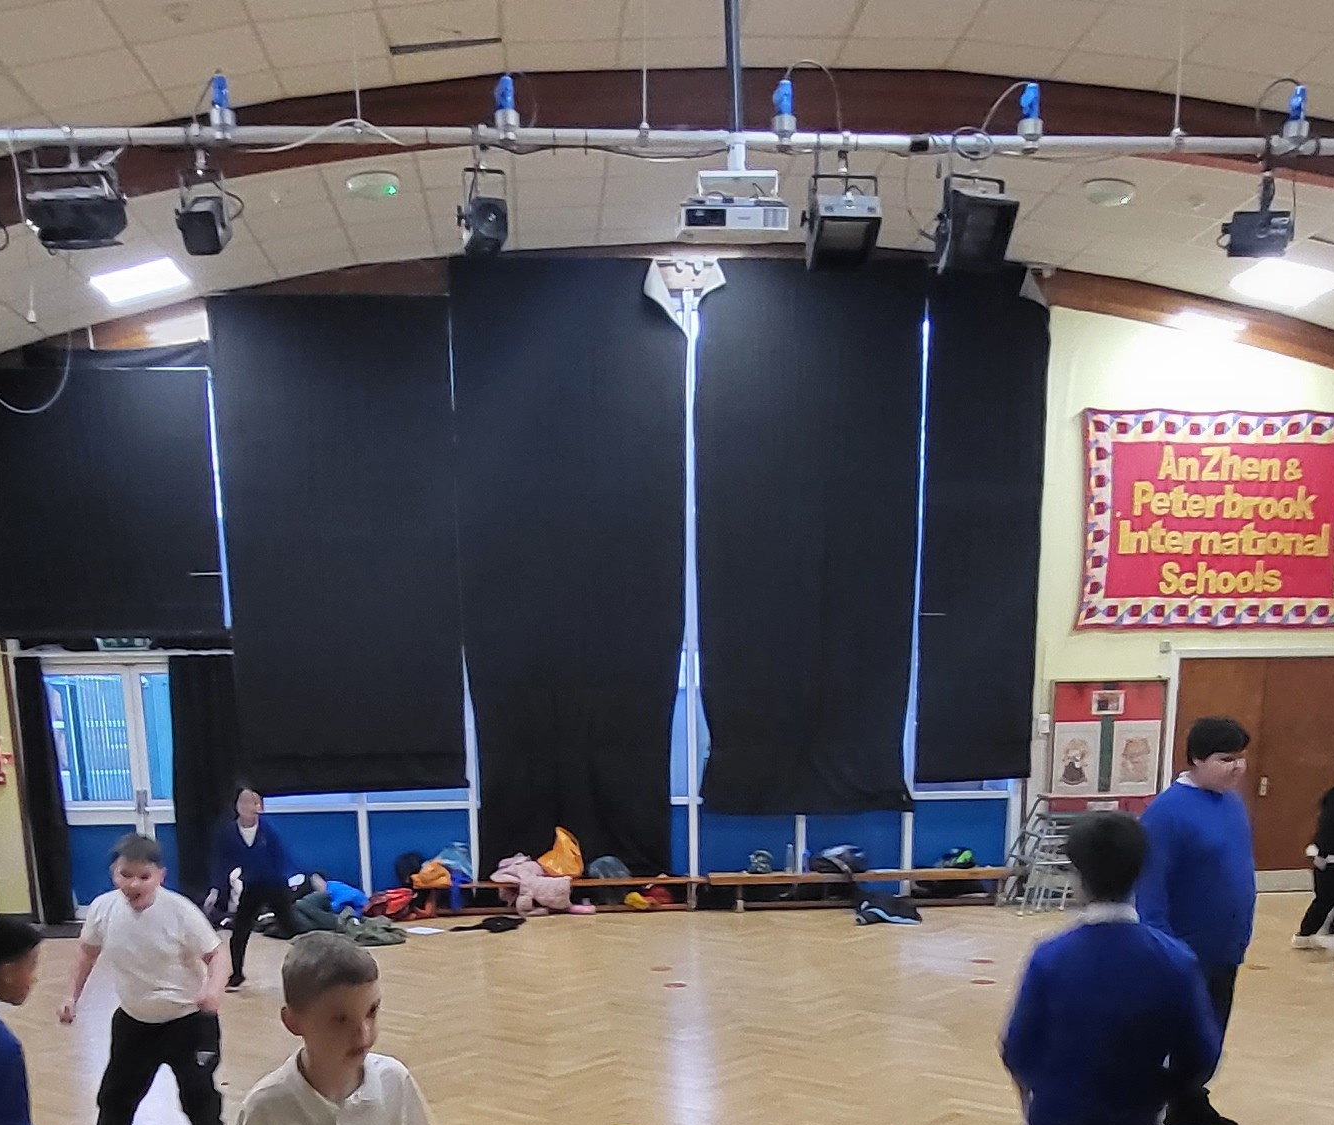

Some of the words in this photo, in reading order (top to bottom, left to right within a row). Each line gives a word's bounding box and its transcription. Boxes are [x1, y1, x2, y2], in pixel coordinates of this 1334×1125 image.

[1283, 457, 1304, 482] &
[1132, 480, 1318, 521] Peterbrook
[1117, 518, 1331, 558] International
[1158, 559, 1283, 596] Schools
